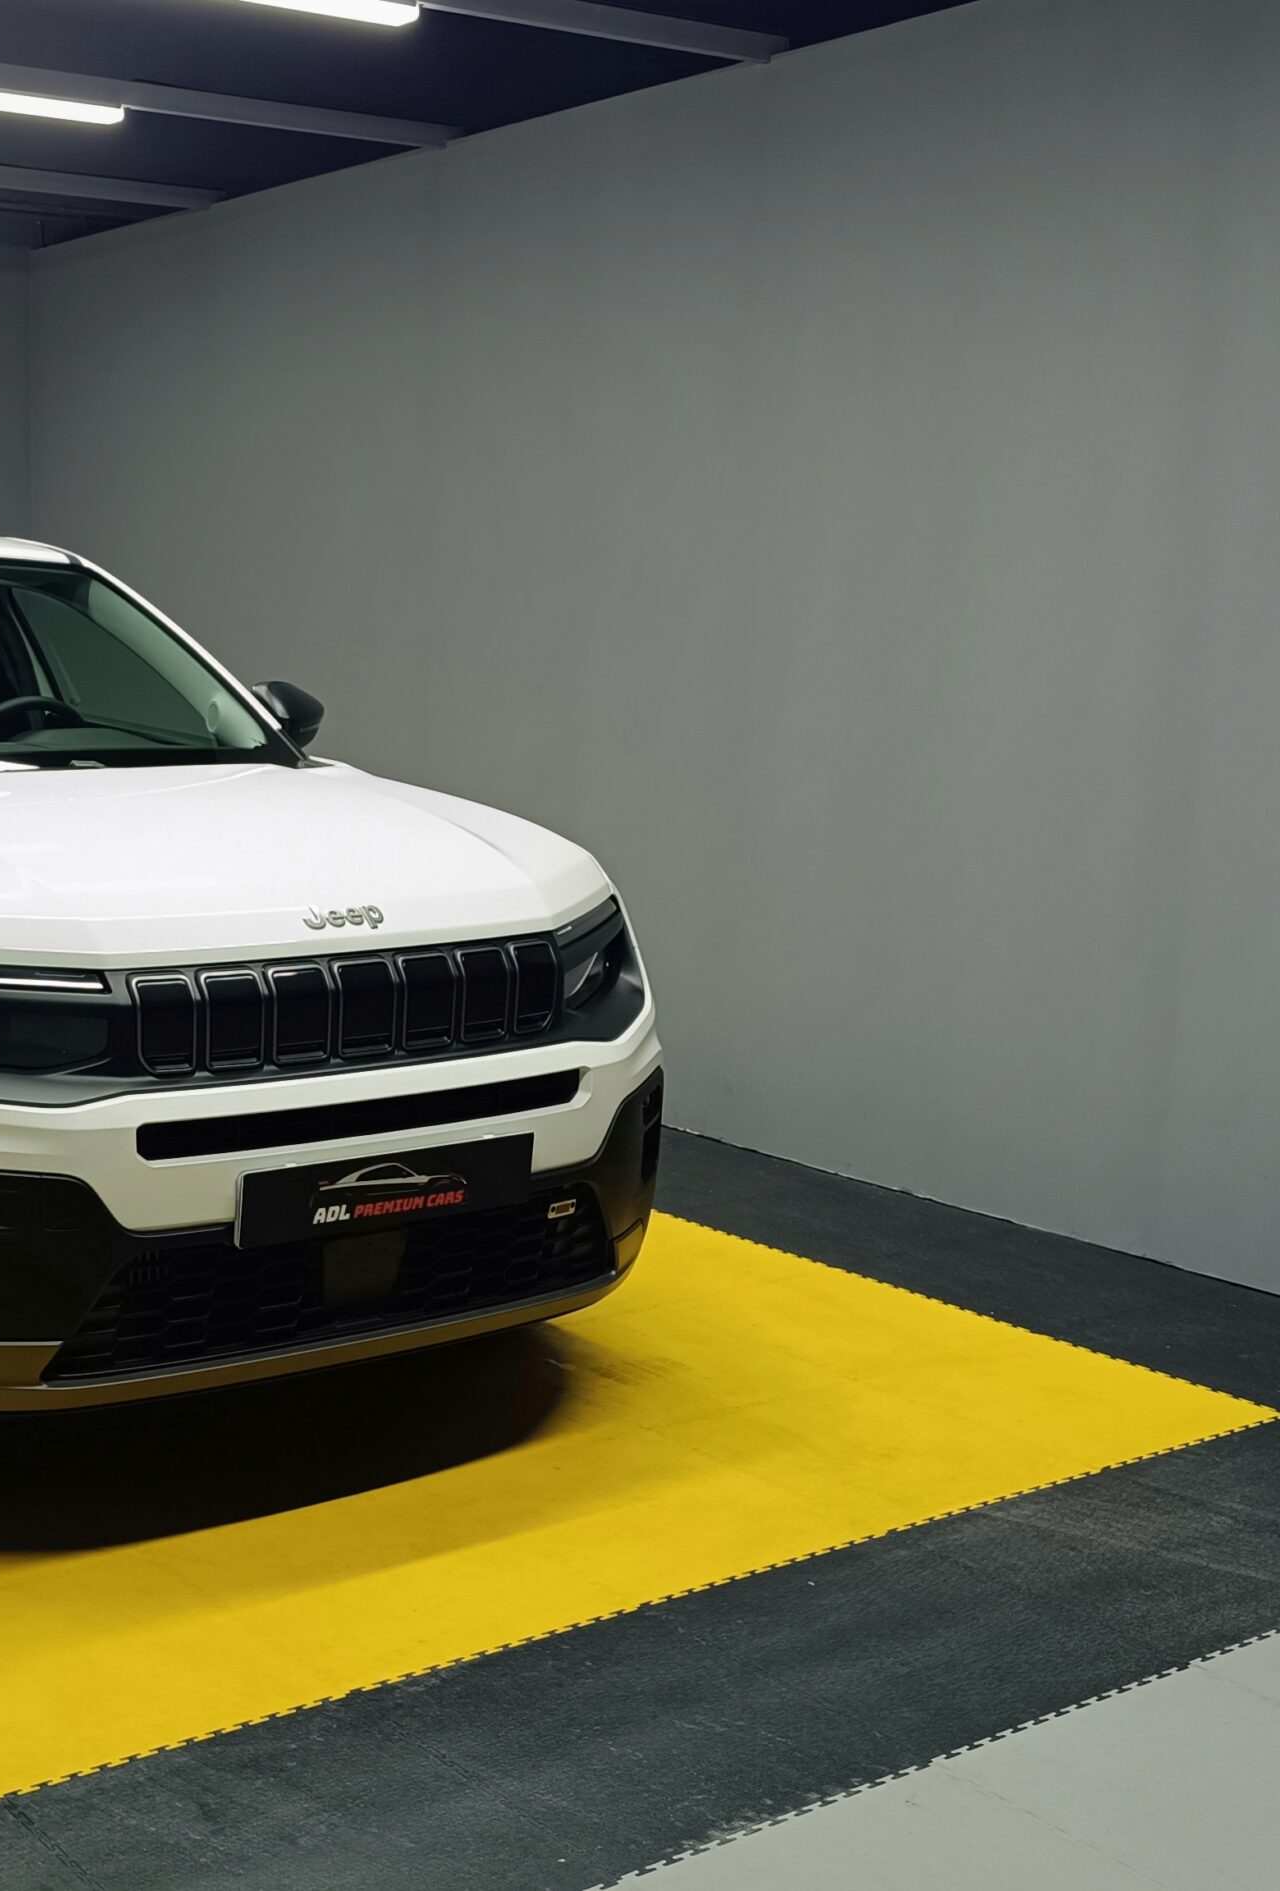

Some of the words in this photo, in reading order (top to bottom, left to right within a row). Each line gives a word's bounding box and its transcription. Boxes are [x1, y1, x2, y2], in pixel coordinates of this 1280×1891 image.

[302, 904, 385, 931] Jeep
[312, 1204, 351, 1225] ADL
[353, 1195, 426, 1218] PREMIUM
[426, 1190, 465, 1208] CARS
